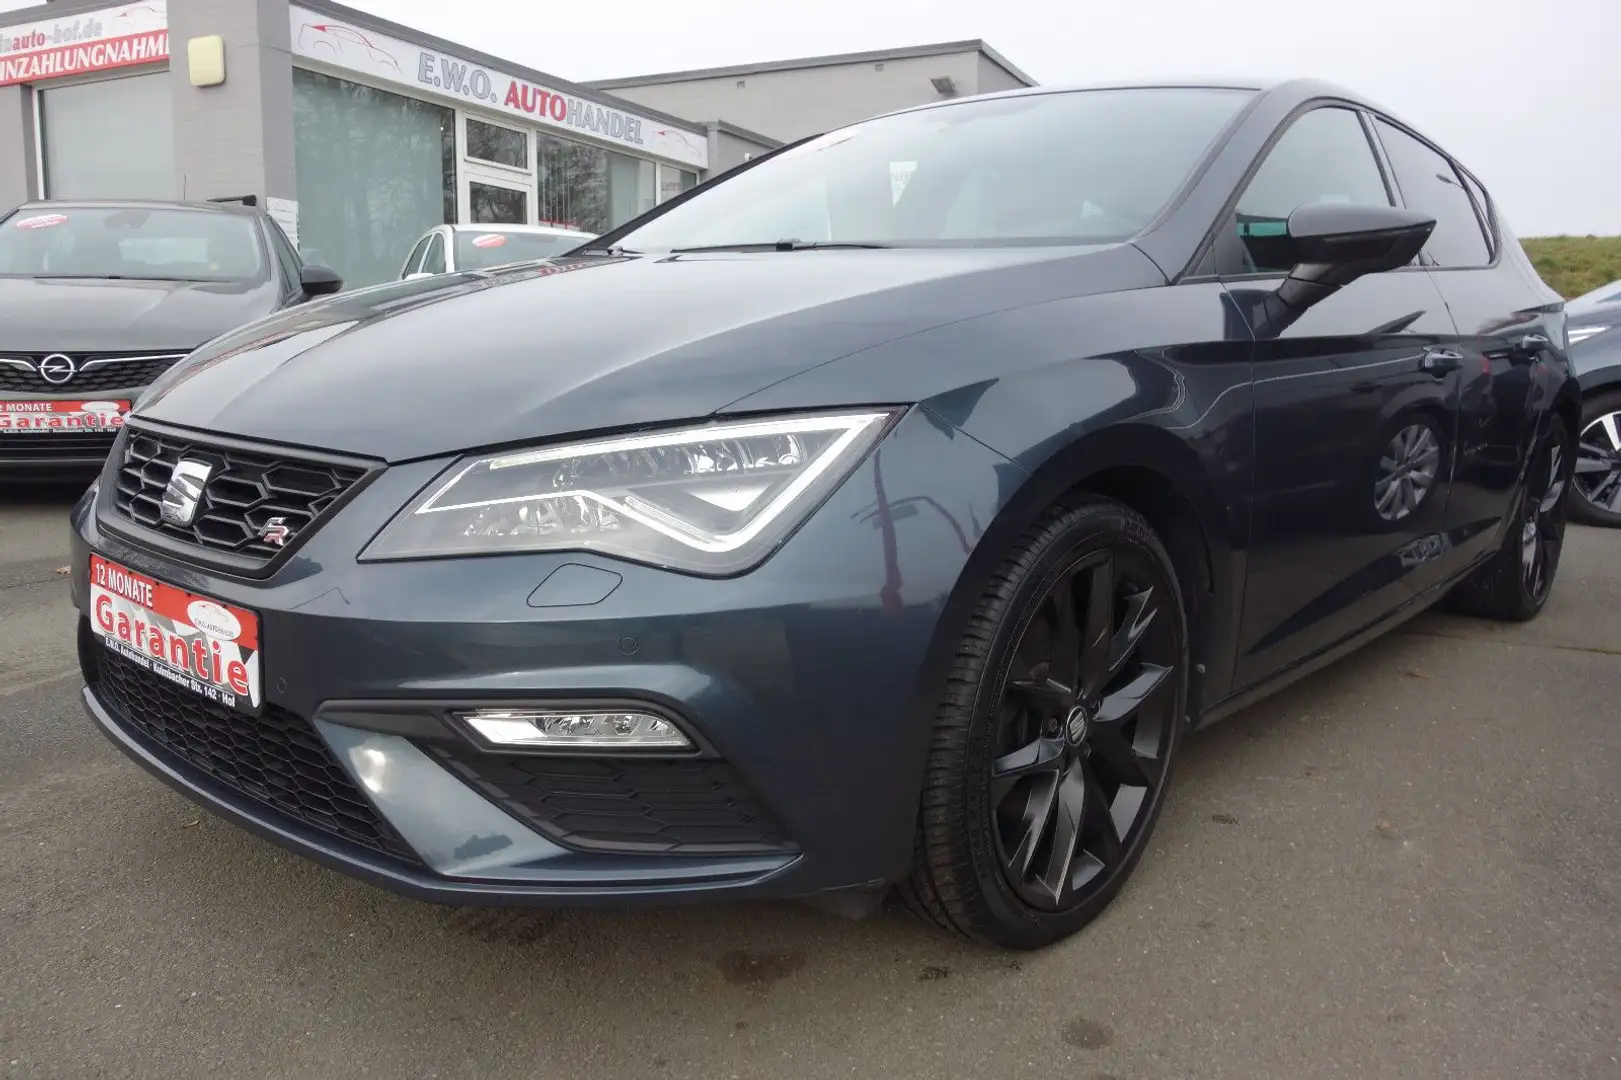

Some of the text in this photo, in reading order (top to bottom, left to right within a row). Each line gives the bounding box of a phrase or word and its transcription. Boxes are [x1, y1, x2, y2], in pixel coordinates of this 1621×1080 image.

[0, 33, 169, 81] INZAHLUNGNAHM
[418, 52, 643, 144] E.W.O. AUTOHANDEL
[0, 412, 126, 428] Garantie
[6, 403, 52, 412] MONATE
[96, 564, 153, 607] 12 MONATE
[96, 594, 249, 697] Garantie
[203, 686, 217, 700] 142
